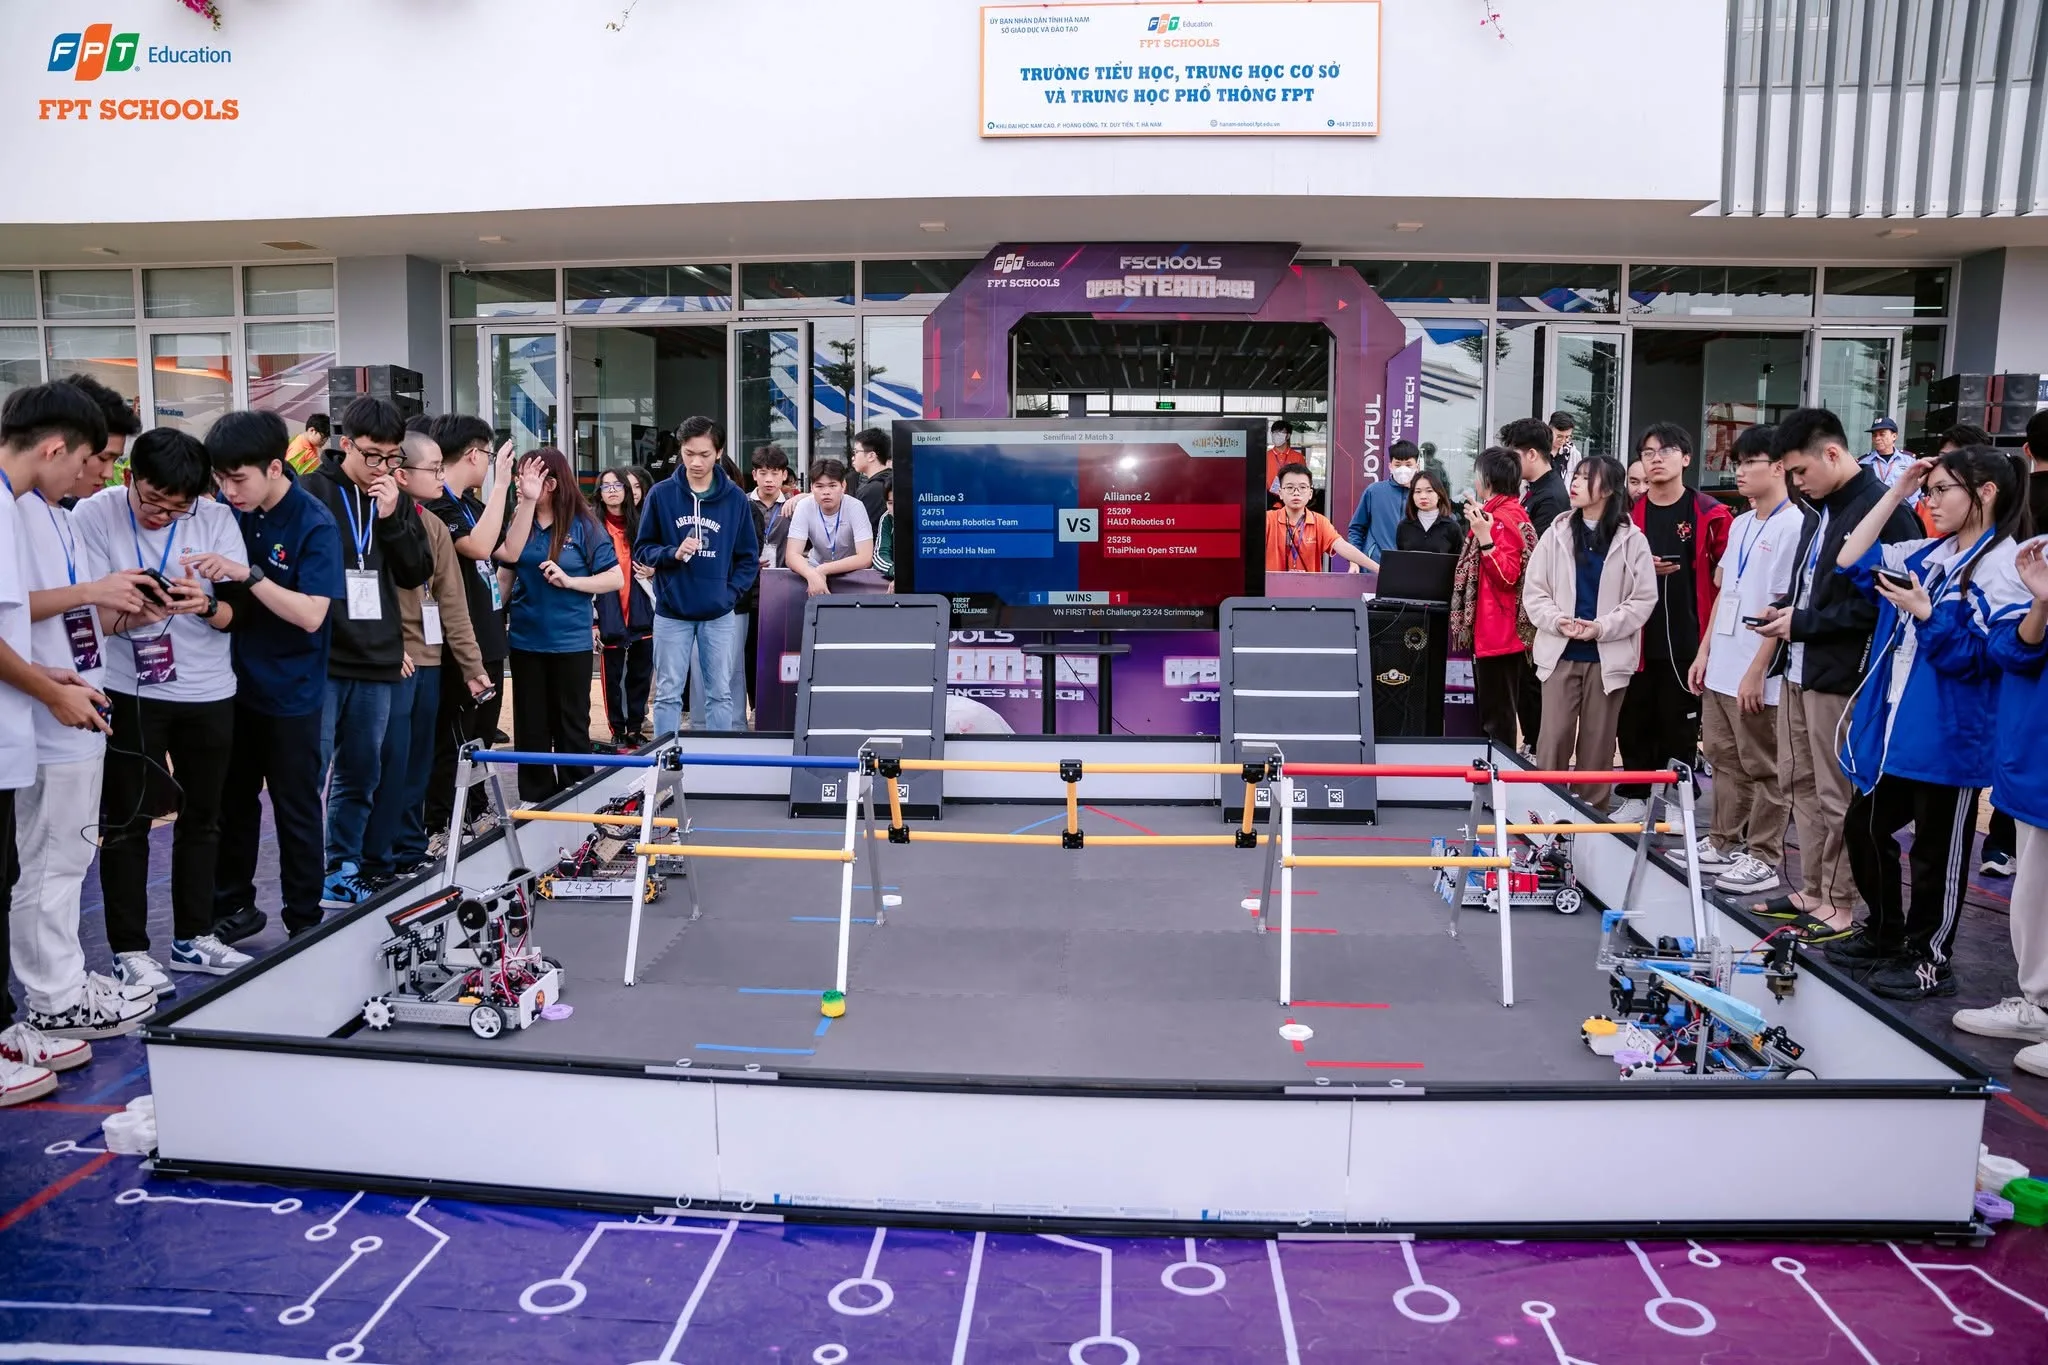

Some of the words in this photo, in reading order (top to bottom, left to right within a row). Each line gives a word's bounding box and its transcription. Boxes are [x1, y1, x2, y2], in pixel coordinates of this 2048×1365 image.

[1140, 40, 1160, 48] FPT
[1164, 39, 1220, 48] SCHOOLS
[1020, 64, 1090, 80] TRƯỜNG
[1095, 61, 1132, 80] TIỂU
[1138, 66, 1180, 82] HỌC,
[1185, 65, 1243, 79] TRUNG
[1248, 65, 1284, 82] HỌC
[1290, 64, 1314, 78] CƠ
[1319, 61, 1340, 78] SỞ
[1045, 88, 1066, 104] VÀ
[1072, 89, 1128, 103] TRUNG
[1134, 89, 1170, 106] HỌC
[1175, 83, 1211, 102] PHỔ
[1217, 86, 1276, 102] THÔNG
[1282, 88, 1314, 102] FPT
[1120, 256, 1222, 270] FSCHOOLS
[1010, 279, 1060, 288] SCHOOLS
[1124, 275, 1216, 298] STEAM
[1404, 376, 1415, 411] TECH
[1404, 414, 1414, 428] IN
[1364, 394, 1381, 482] JOYFUL
[918, 493, 956, 502] Alliance
[958, 493, 964, 502] 3
[1104, 492, 1142, 501] Alliance
[1144, 492, 1150, 501] 2
[1067, 518, 1091, 532] VS
[1147, 547, 1167, 555] Open
[1036, 594, 1041, 602] 1
[1066, 594, 1092, 602] WINS
[1116, 594, 1121, 602] 1
[1106, 608, 1140, 617] Challenge
[1164, 609, 1204, 617] Scrimmage
[566, 882, 613, 894] 24751
